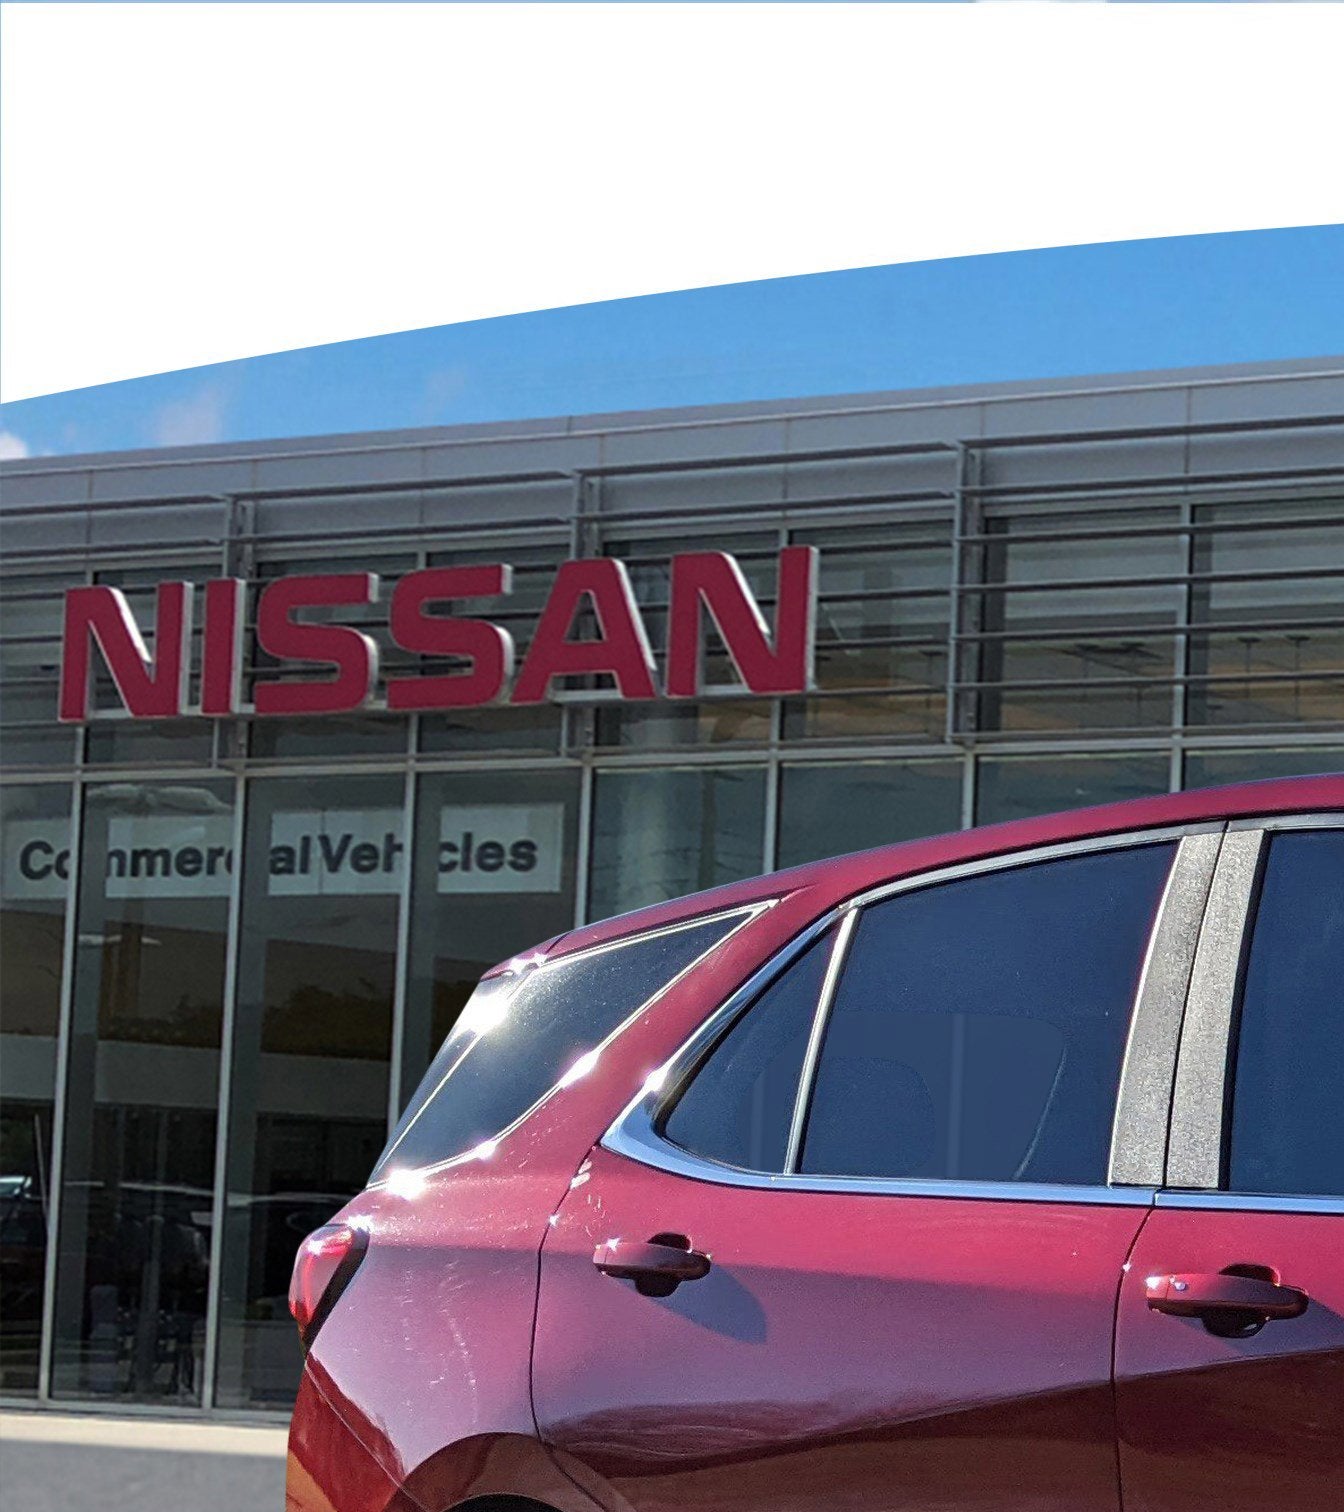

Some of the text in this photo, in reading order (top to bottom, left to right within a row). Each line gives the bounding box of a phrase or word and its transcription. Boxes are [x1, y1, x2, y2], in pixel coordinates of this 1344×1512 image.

[57, 545, 818, 723] NISSAN
[19, 831, 538, 881] Commeral Vehcles
